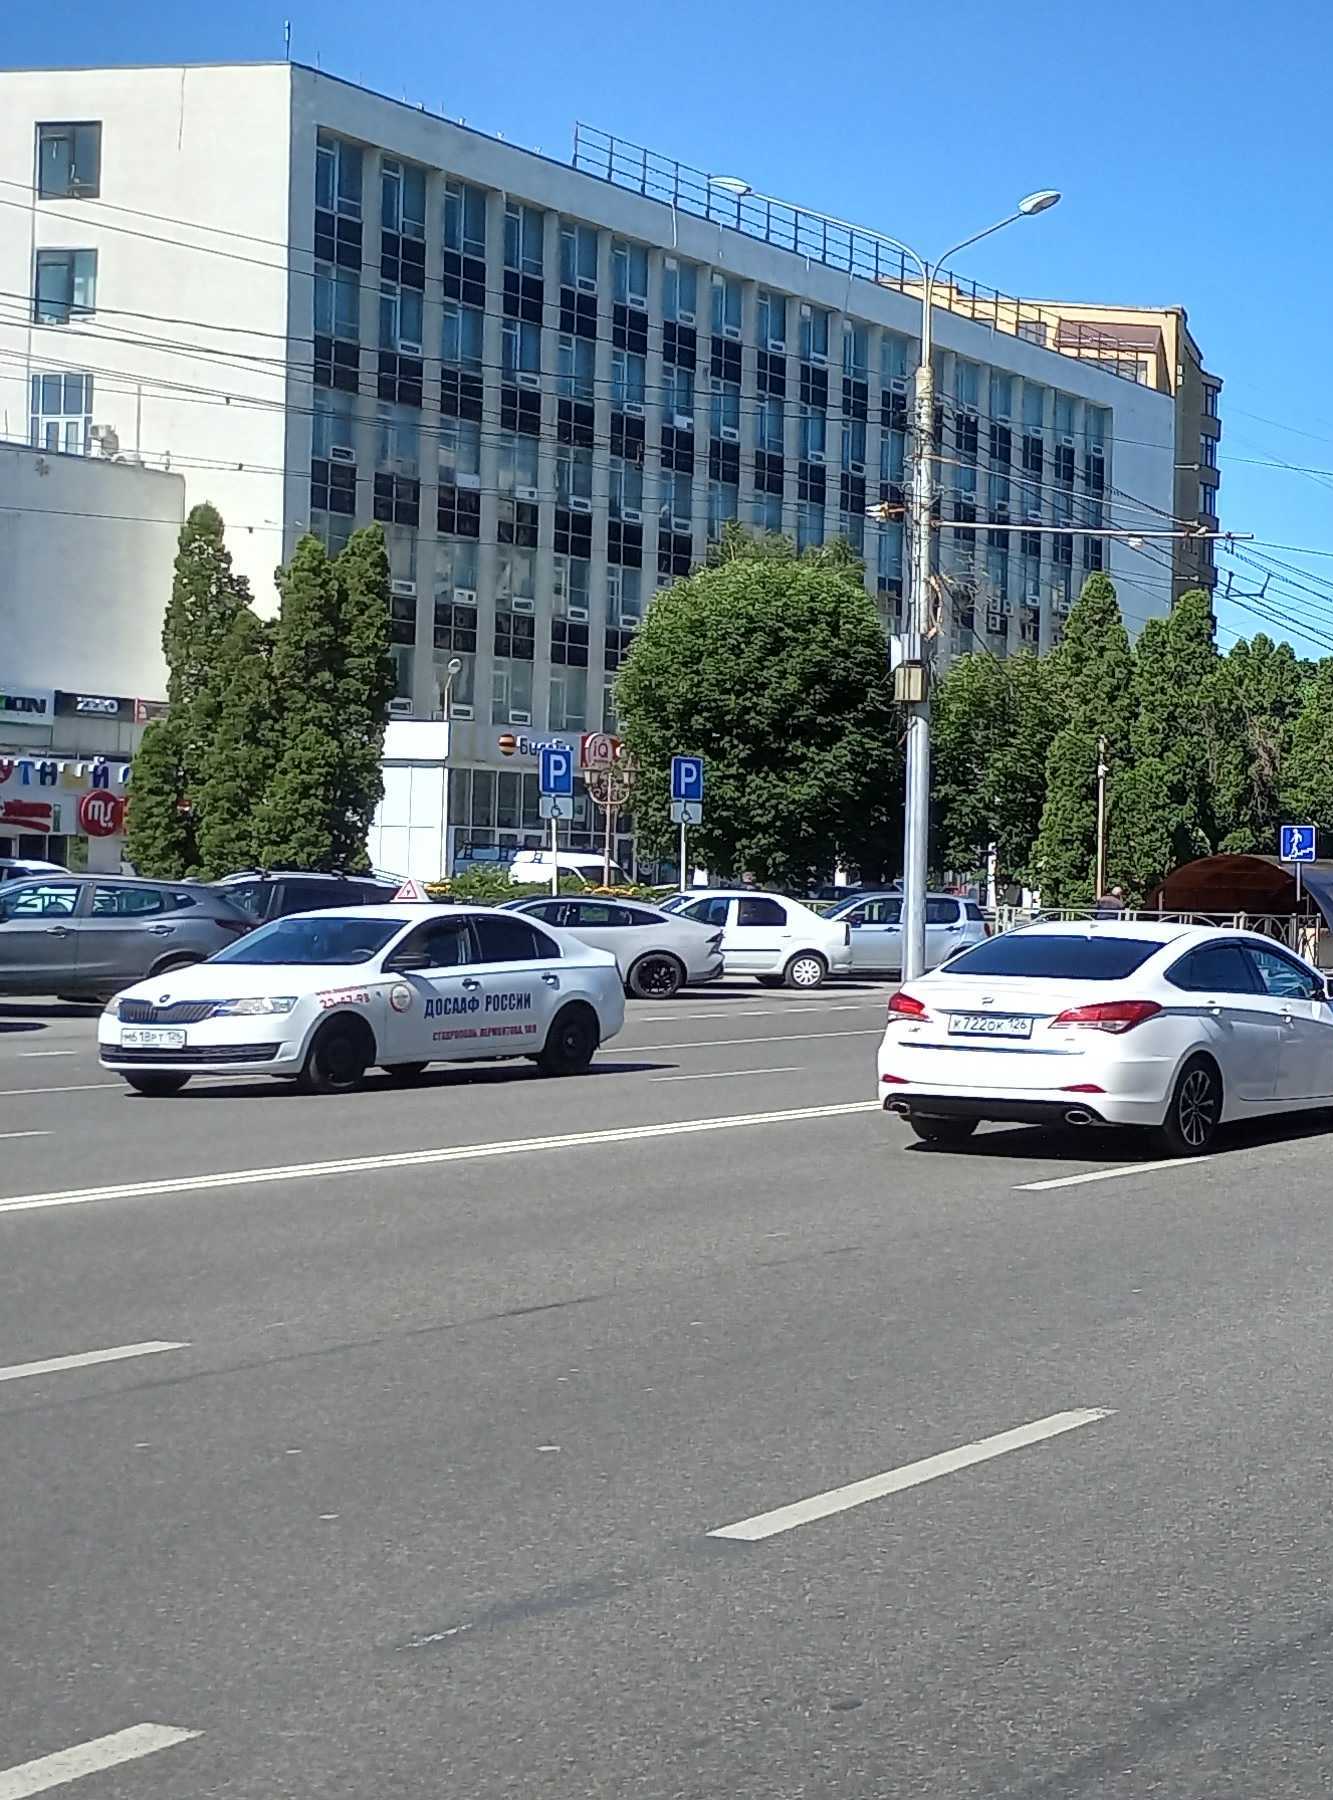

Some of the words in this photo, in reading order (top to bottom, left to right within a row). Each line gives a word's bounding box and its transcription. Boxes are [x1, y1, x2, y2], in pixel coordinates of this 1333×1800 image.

[75, 697, 119, 713] ZERO
[550, 754, 567, 789] P
[680, 762, 697, 795] P
[424, 997, 481, 1019] ДОСААФ
[485, 992, 532, 1012] РОССИИ
